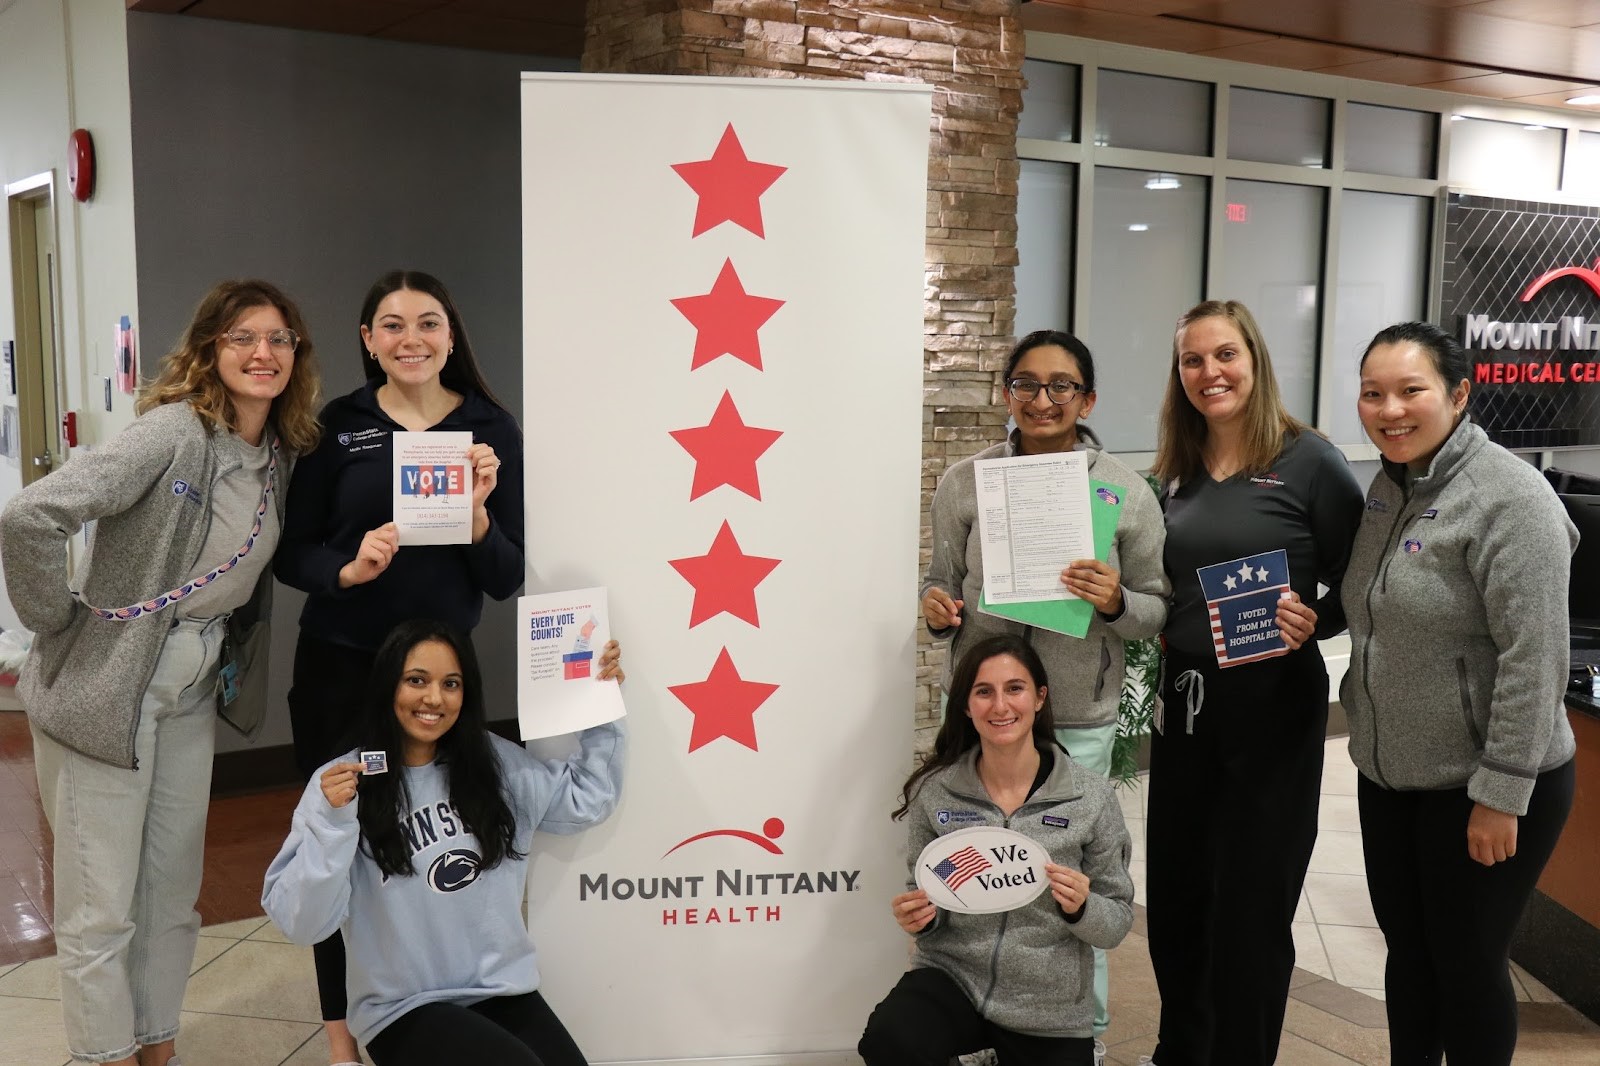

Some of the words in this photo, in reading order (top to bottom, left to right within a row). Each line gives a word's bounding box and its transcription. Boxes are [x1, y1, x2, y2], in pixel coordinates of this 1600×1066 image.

[1465, 313, 1558, 350] MOUNT
[1475, 362, 1565, 384] MEDICAL
[406, 470, 458, 490] VOTE
[531, 616, 554, 629] EVERY
[556, 613, 575, 626] VOTE
[1238, 612, 1242, 620] I
[1242, 607, 1267, 620] VOTED
[531, 626, 563, 640] COUNTS!
[1236, 622, 1258, 633] FROM
[1260, 619, 1272, 629] MY
[1230, 632, 1265, 646] HOSPITAL
[1266, 629, 1280, 639] BED
[990, 844, 1028, 864] We
[579, 872, 704, 901] MOUNT
[975, 867, 1037, 891] Voted
[663, 905, 780, 925] HEALTH
